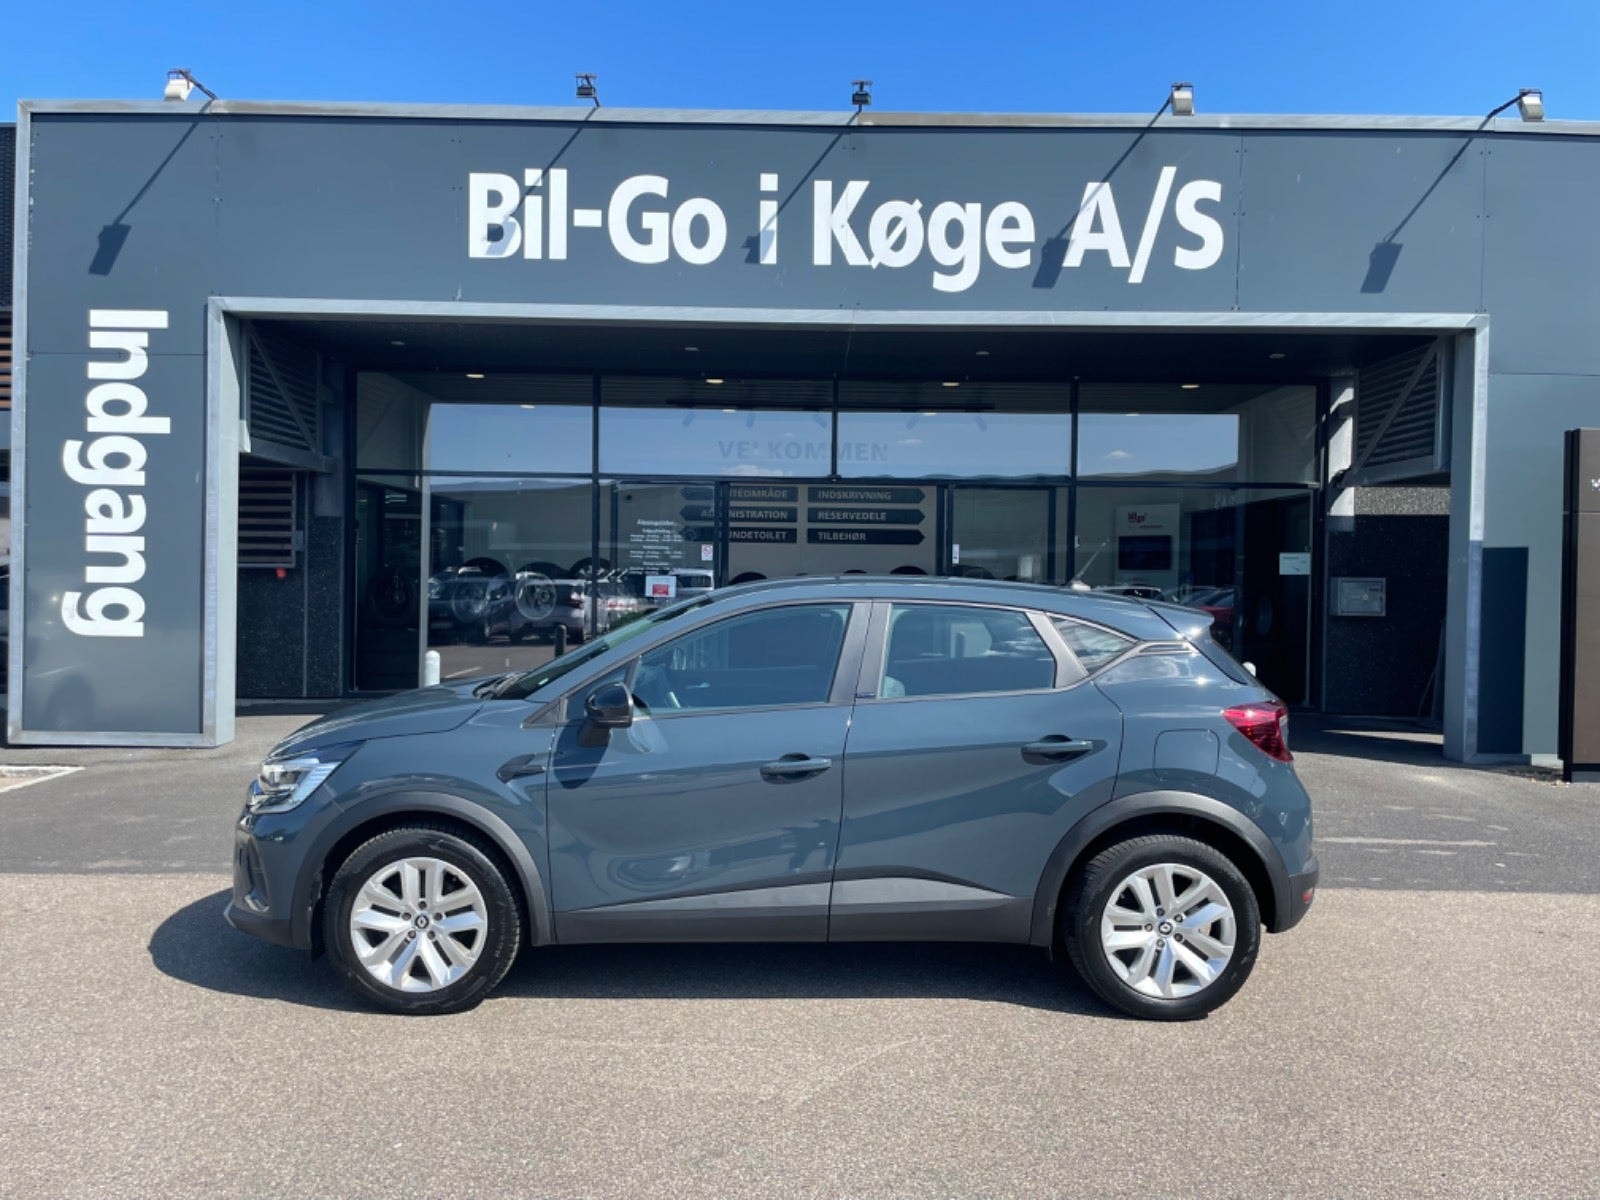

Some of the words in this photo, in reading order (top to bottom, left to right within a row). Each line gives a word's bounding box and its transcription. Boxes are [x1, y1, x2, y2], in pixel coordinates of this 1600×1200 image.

[468, 168, 727, 265] Bil-Go
[760, 173, 778, 265] i
[813, 180, 1036, 293] Køge
[1062, 166, 1224, 284] A/S
[718, 440, 888, 462] VEKOMMEN
[61, 309, 171, 637] Indgang
[818, 490, 892, 500] INDSKRIVNING
[701, 510, 788, 519] ADNISTRATION
[817, 511, 887, 521] RESERVEDELE
[728, 531, 787, 540] NDETOILET
[817, 531, 866, 541] TILBEHØR
